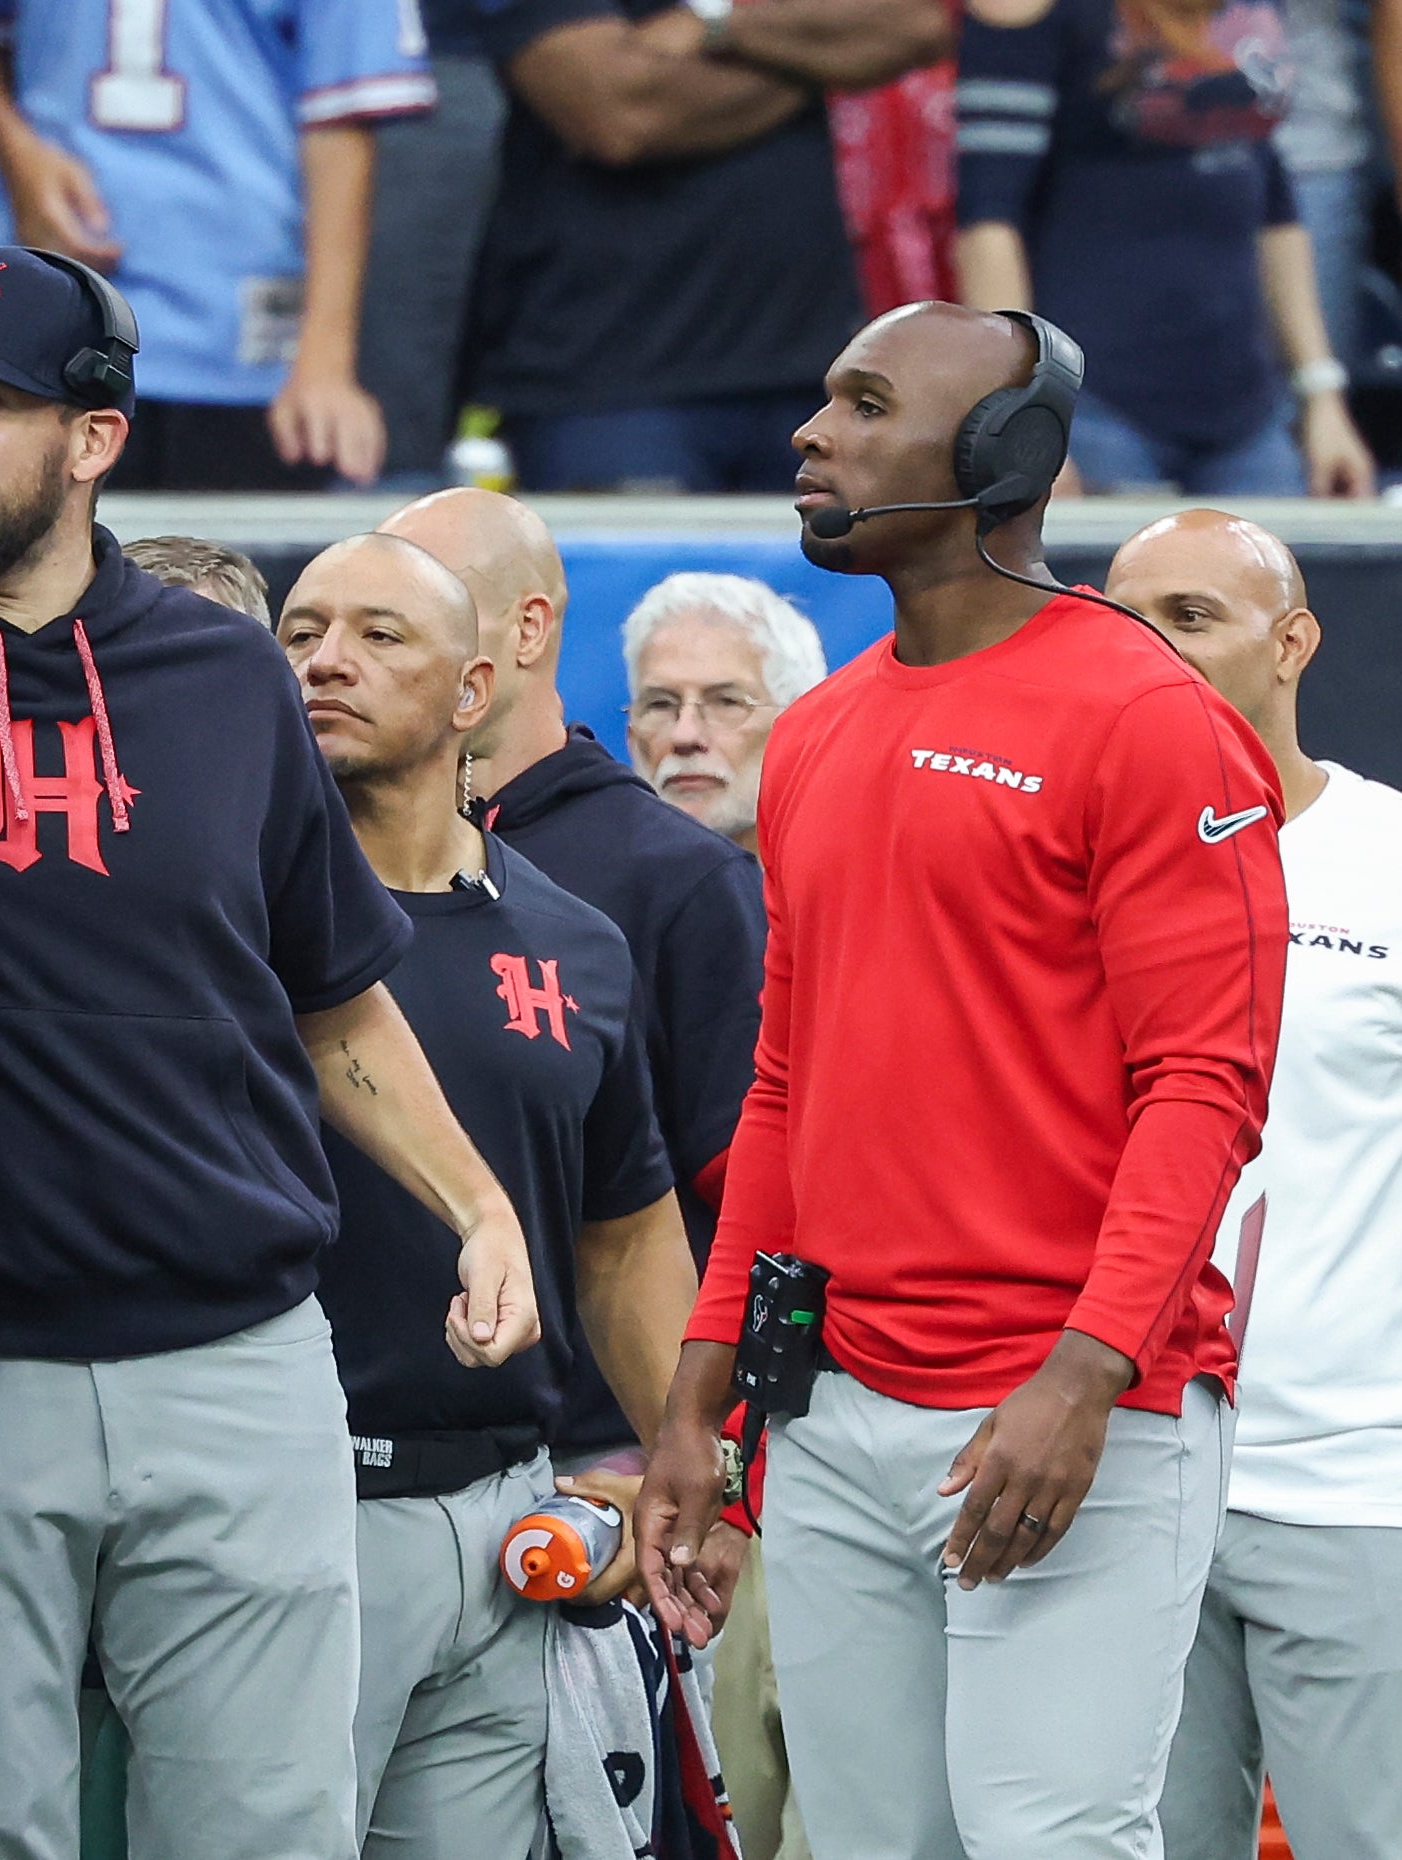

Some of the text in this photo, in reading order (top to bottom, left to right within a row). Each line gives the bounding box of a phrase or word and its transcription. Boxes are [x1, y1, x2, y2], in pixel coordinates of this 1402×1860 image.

[910, 748, 1044, 793] TEXANS
[488, 952, 572, 1052] H
[362, 1451, 393, 1468] BAGS
